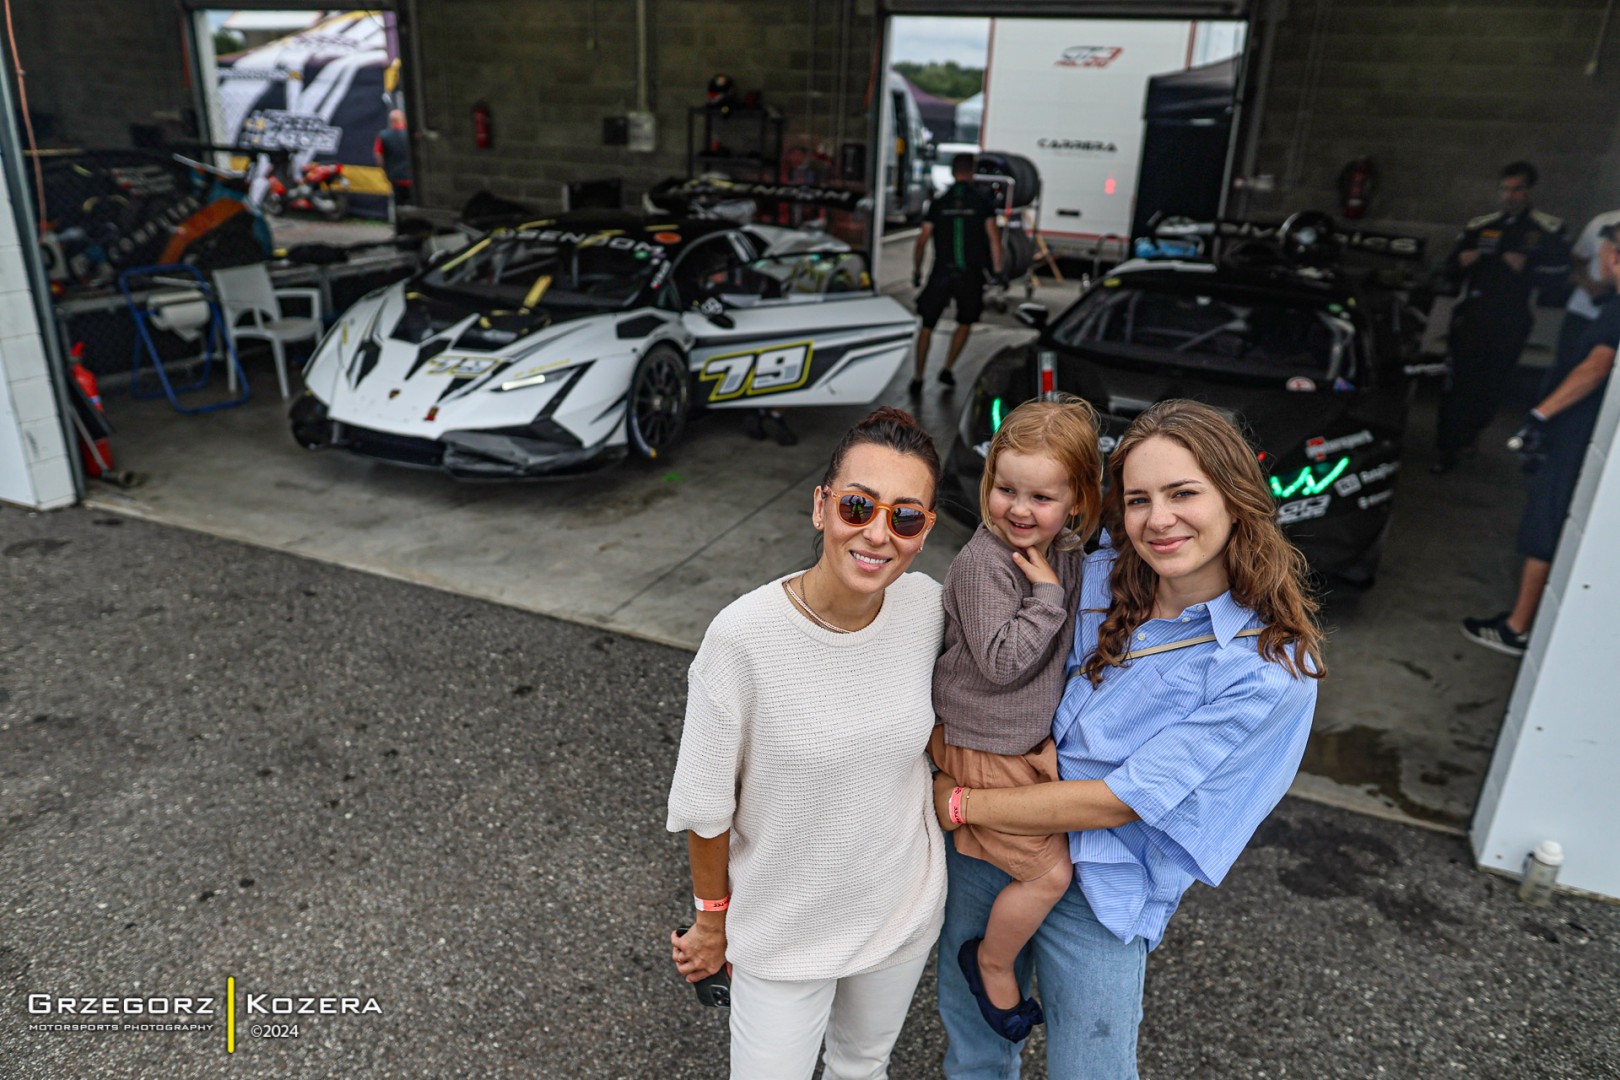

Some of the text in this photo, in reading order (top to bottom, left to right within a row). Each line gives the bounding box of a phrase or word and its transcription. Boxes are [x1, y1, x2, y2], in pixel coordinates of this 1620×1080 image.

[1037, 138, 1118, 152] CARRERA
[427, 355, 501, 378] 79
[699, 340, 815, 401] 79
